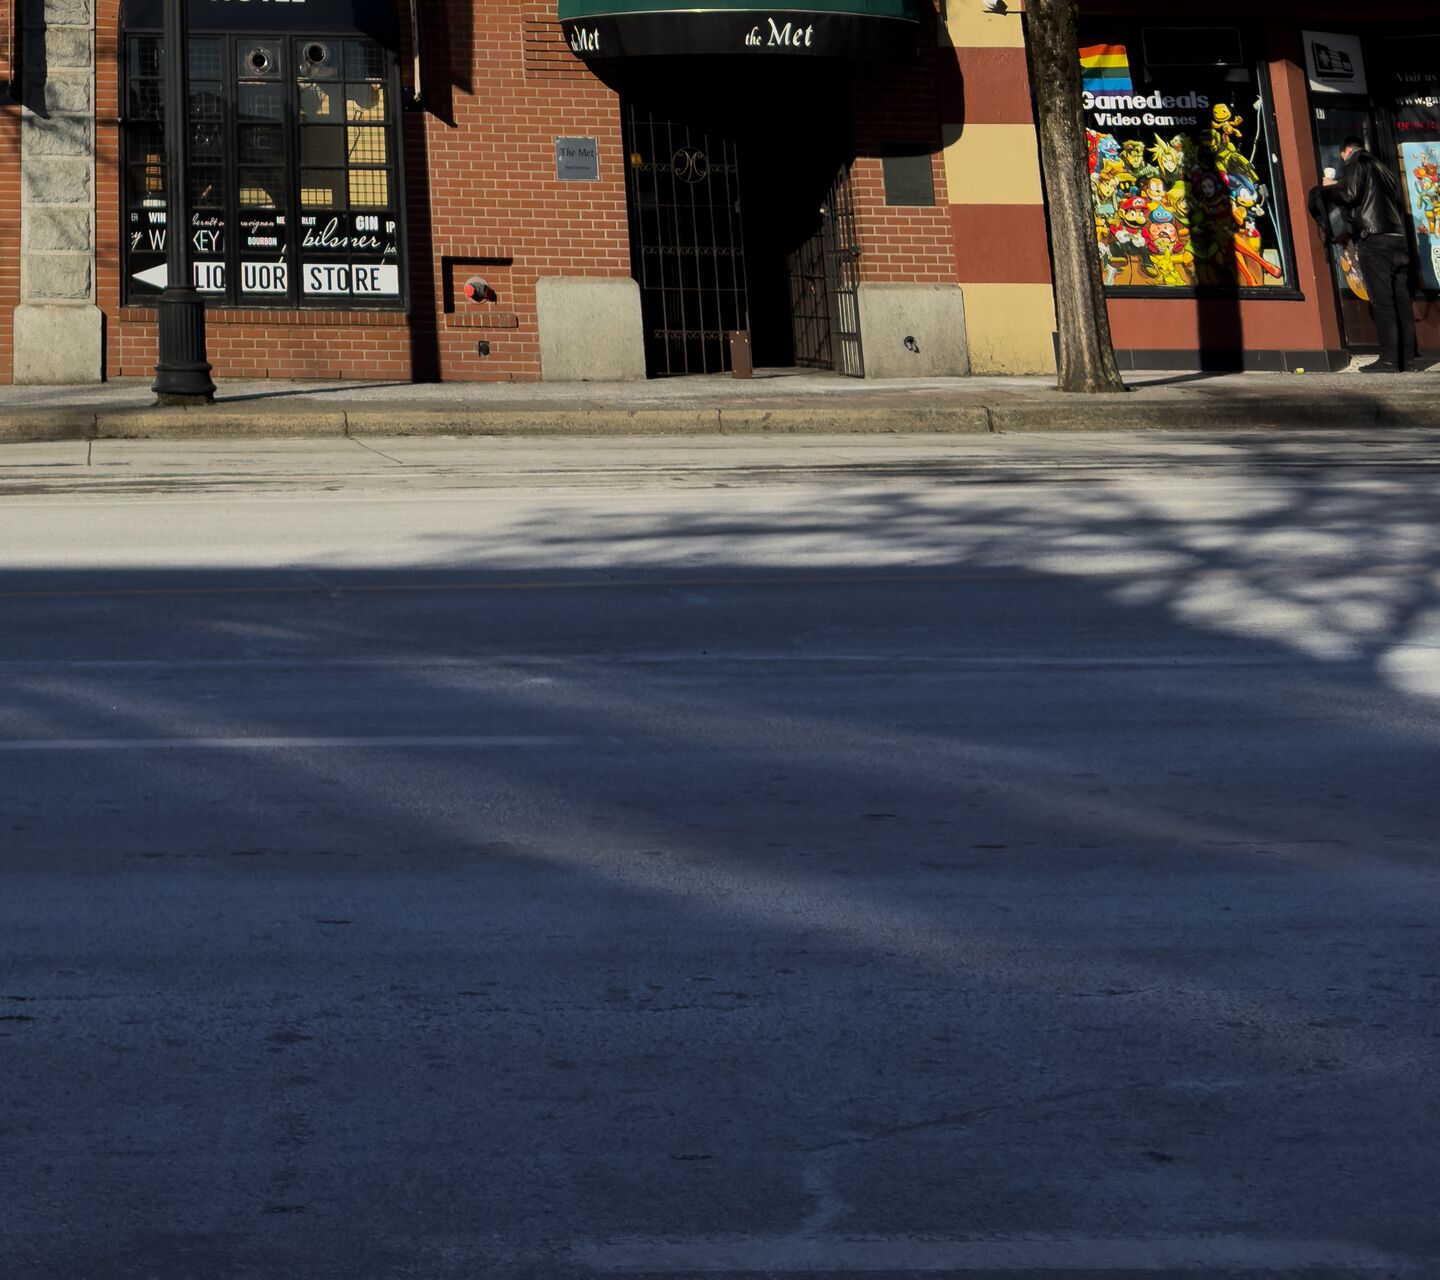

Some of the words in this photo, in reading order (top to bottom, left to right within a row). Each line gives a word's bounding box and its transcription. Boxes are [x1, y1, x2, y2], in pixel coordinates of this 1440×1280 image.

[744, 26, 763, 47] the
[766, 17, 814, 48] Met
[1082, 90, 1210, 110] Gamedeals
[1093, 113, 1142, 127] Video
[1142, 113, 1198, 127] Games
[560, 147, 576, 158] The
[578, 148, 595, 158] Met
[148, 212, 167, 224] WIN
[355, 215, 379, 231] GIN
[247, 236, 278, 246] BOURBON
[195, 265, 287, 290] LIQUOR
[311, 267, 383, 292] STORE
